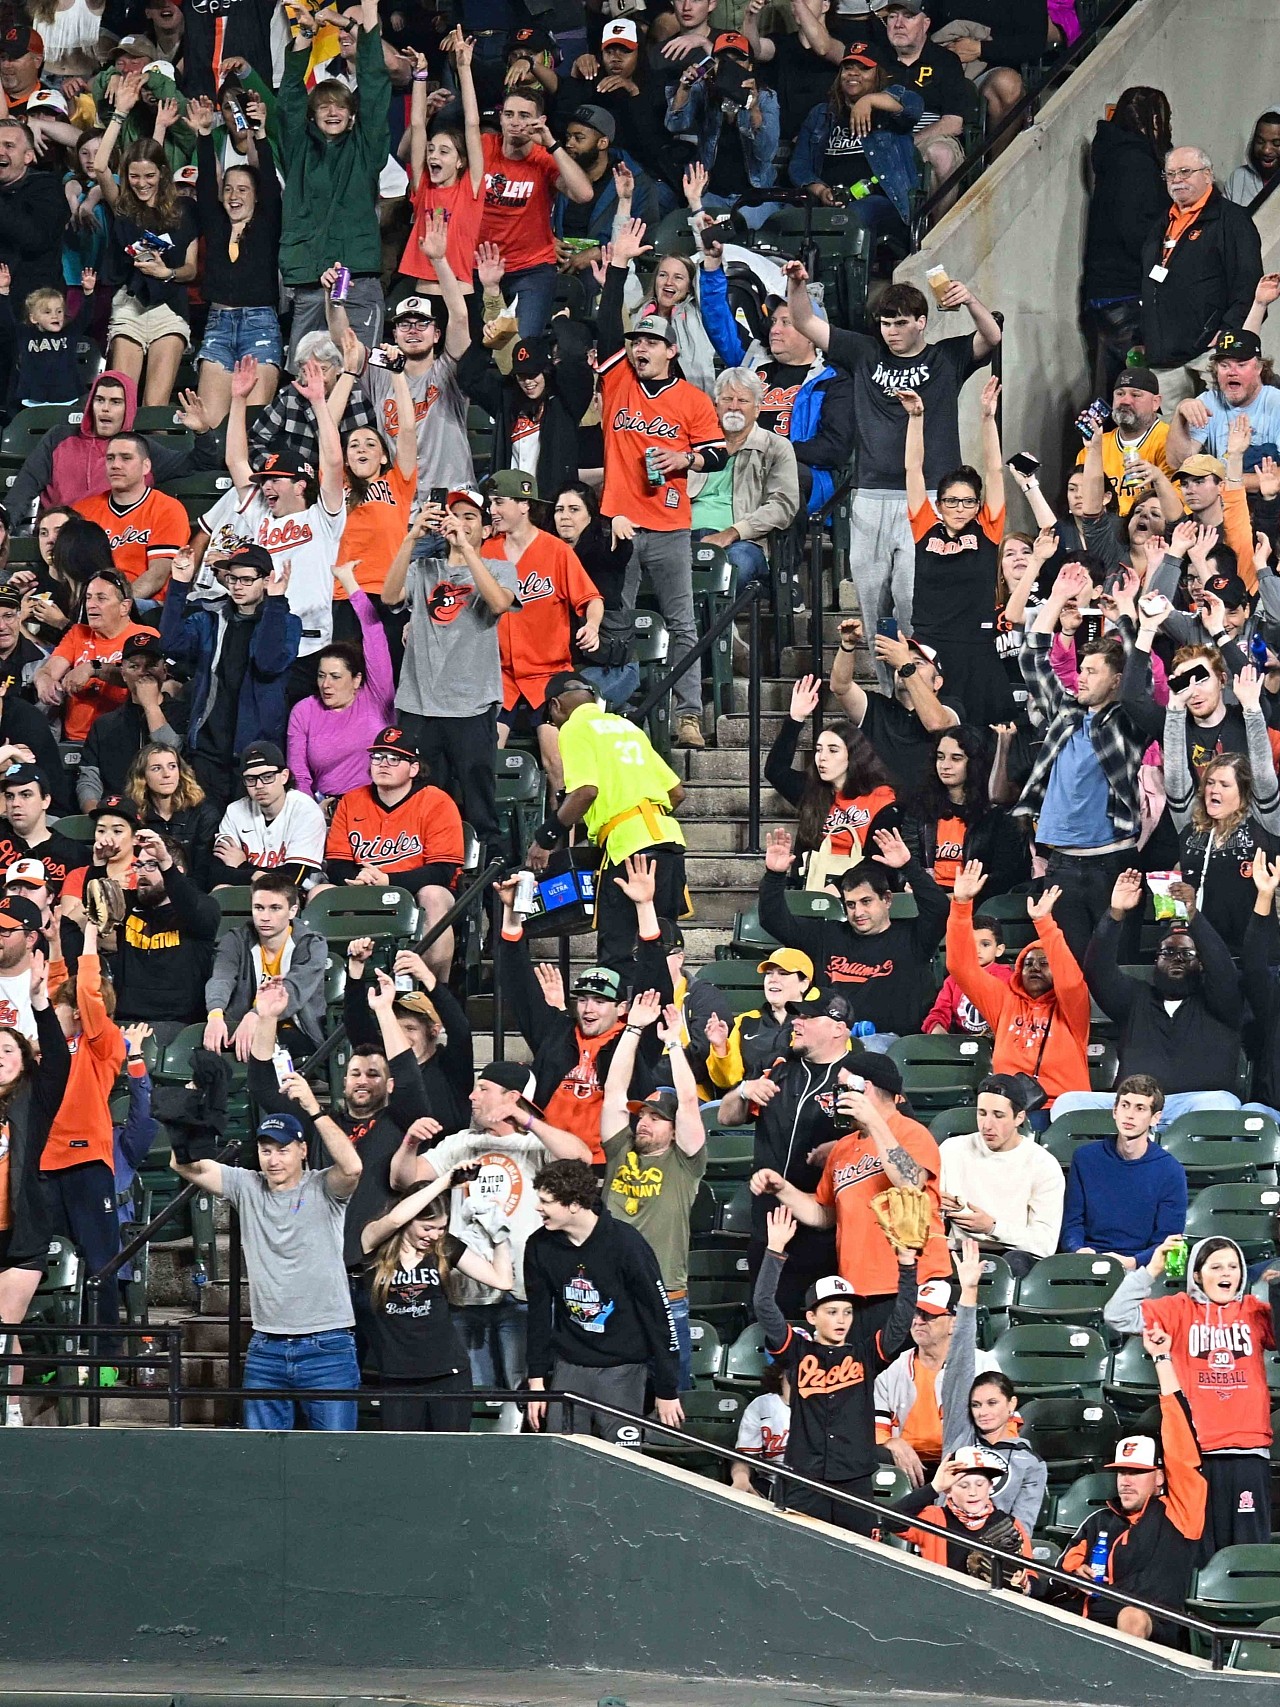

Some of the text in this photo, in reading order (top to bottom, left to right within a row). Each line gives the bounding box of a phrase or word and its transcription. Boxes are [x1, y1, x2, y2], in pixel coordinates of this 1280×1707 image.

[918, 66, 933, 83] P
[28, 336, 69, 352] NAVY
[613, 407, 680, 440] Orioles
[346, 831, 422, 863] Orioles
[546, 885, 569, 899] ULTRA
[610, 1178, 662, 1197] BEAT NAVY
[1189, 1322, 1252, 1358] ORIOLES
[1214, 1352, 1230, 1363] 30
[1198, 1371, 1247, 1384] BASEBALL
[616, 1425, 640, 1441] G
